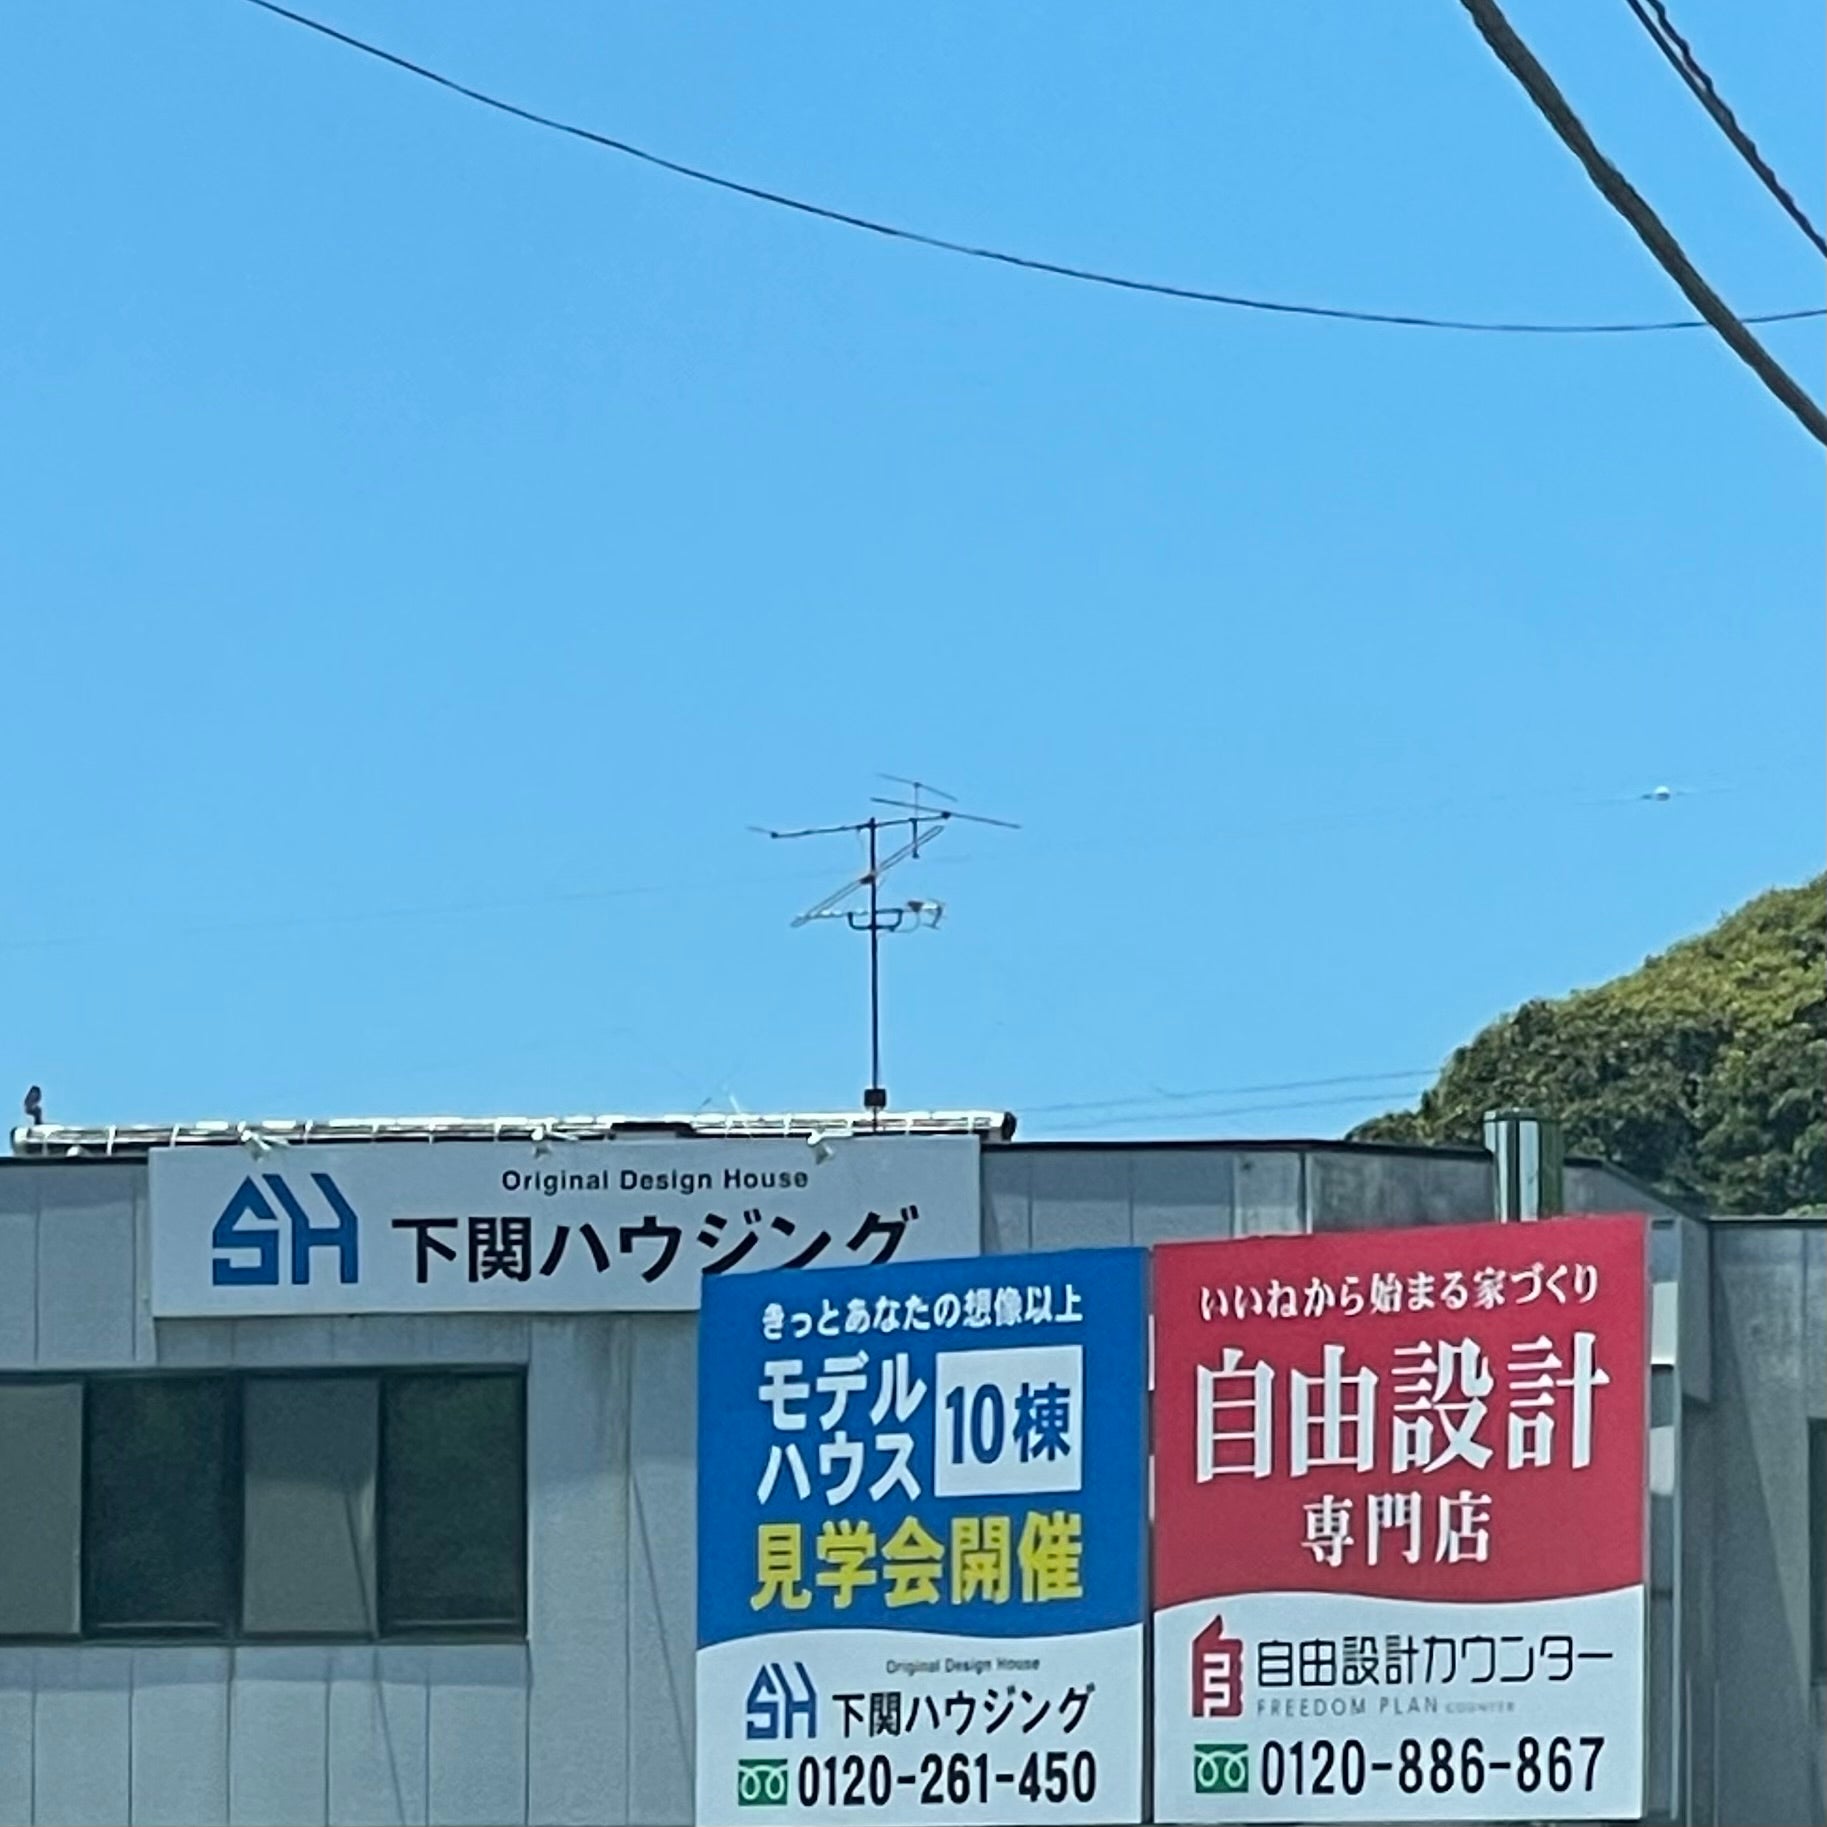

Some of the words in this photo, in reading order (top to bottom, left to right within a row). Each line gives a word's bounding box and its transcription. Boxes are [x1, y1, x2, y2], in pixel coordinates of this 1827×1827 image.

[502, 1169, 609, 1196] Original
[619, 1169, 713, 1196] Design
[723, 1168, 809, 1191] House
[391, 1204, 920, 1284] 下関ハウジング
[762, 1284, 1083, 1340] きっとあなたの想像以上
[1200, 1262, 1599, 1321] いいねから始まる家づくり
[758, 1349, 927, 1431] モデル
[1195, 1331, 1610, 1484] 自由設計
[944, 1382, 1071, 1464] 10棟
[757, 1431, 922, 1506] ハウス
[1301, 1490, 1492, 1568] 専門店
[750, 1510, 1083, 1611] 見学会開催
[886, 1658, 940, 1677] Original
[945, 1657, 991, 1675] Design
[997, 1657, 1040, 1671] House
[1257, 1635, 1613, 1687] 自由設計カウンター
[832, 1682, 1096, 1739] 下関ハウジング
[1257, 1697, 1366, 1717] FREEDOM
[1379, 1696, 1439, 1715] PLAN
[799, 1750, 1097, 1806] 0120-261-450
[1261, 1736, 1605, 1795] 0120-886-867
